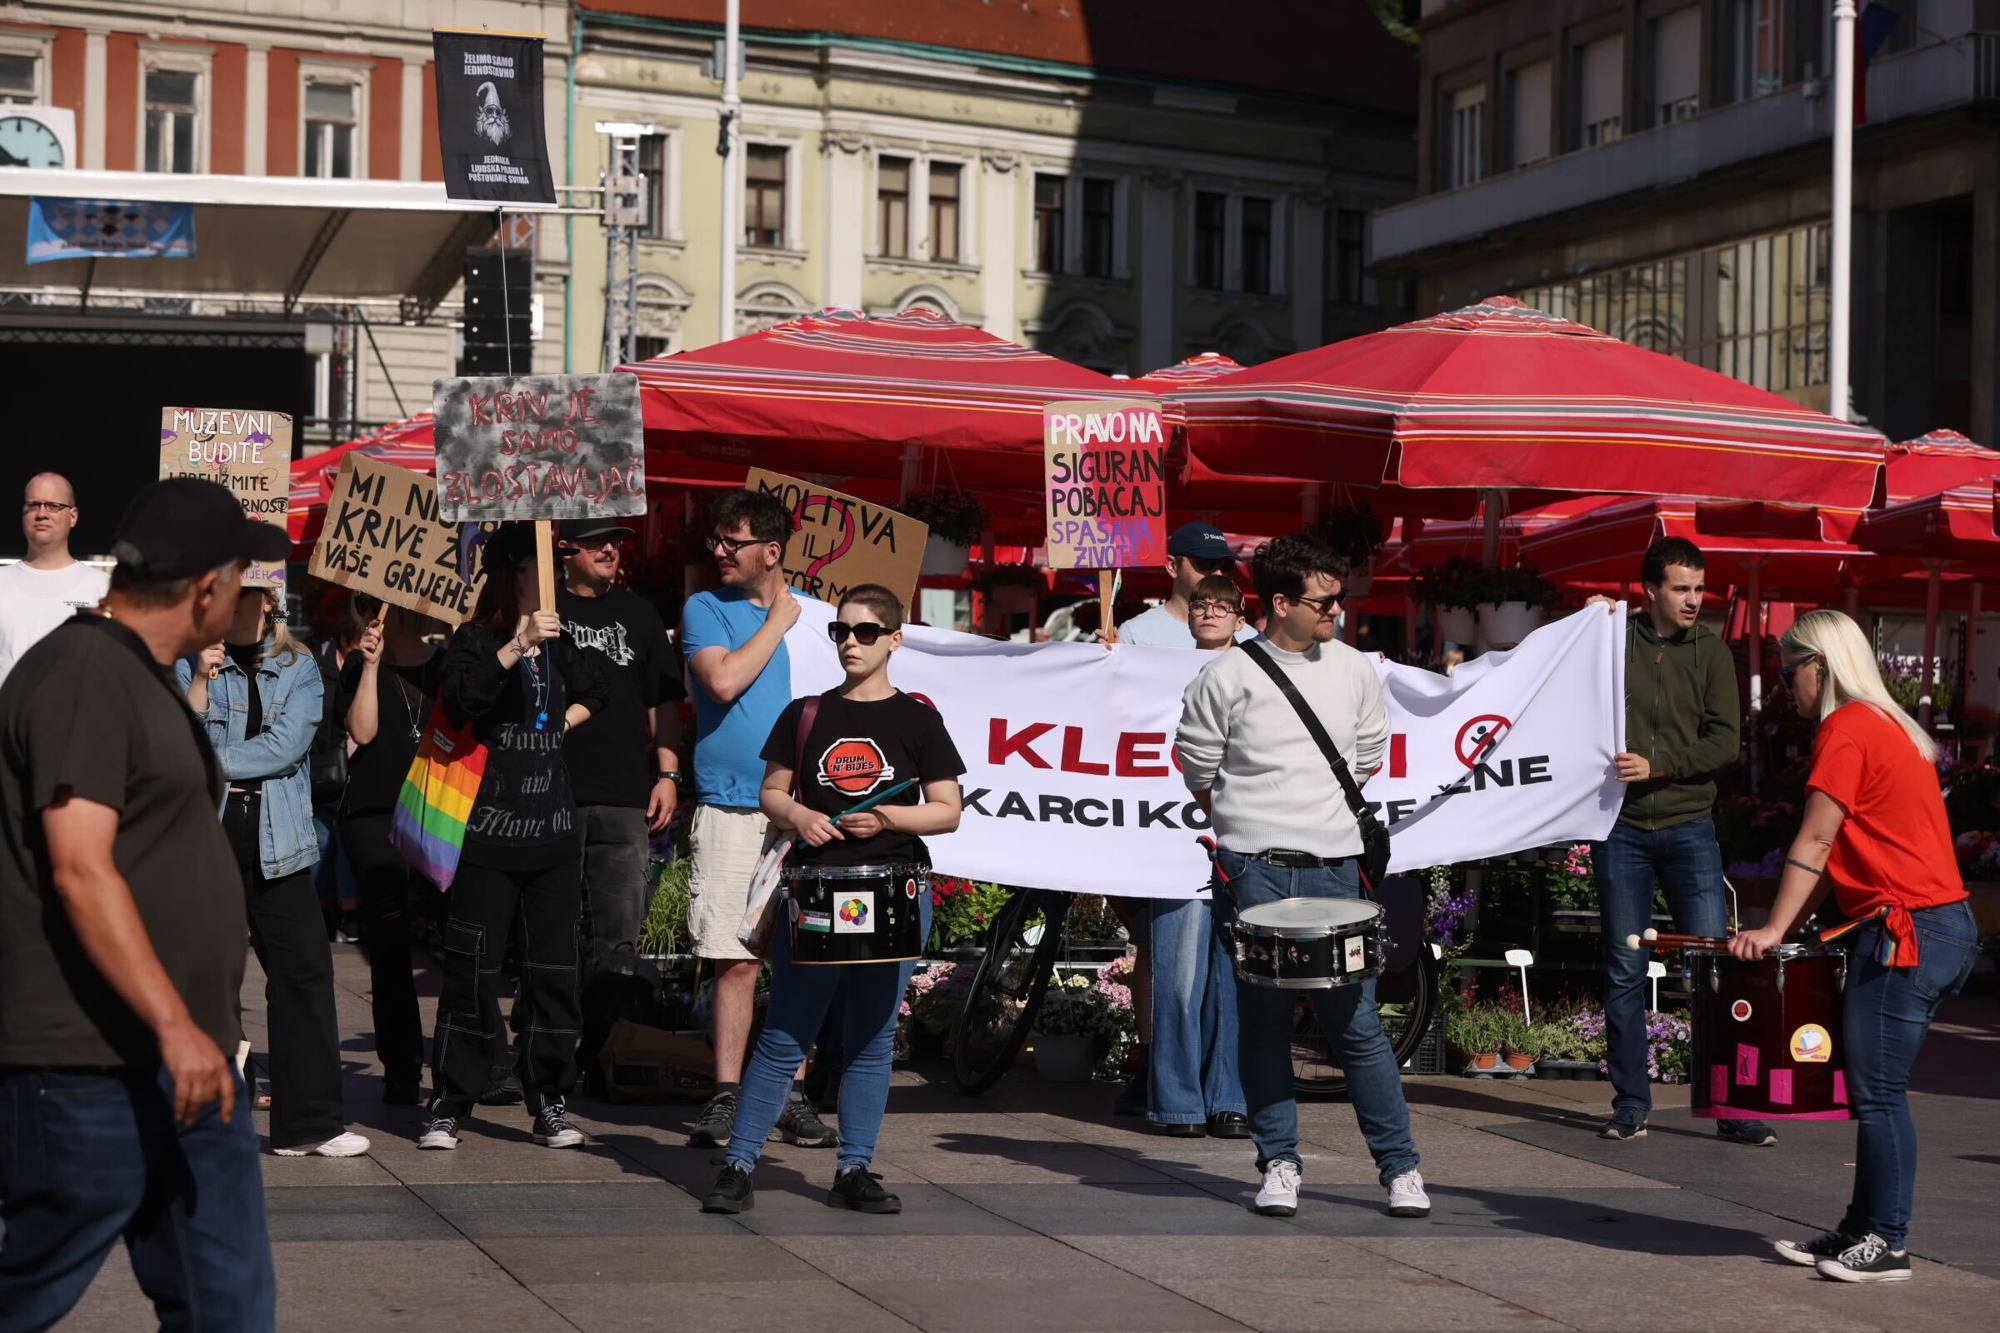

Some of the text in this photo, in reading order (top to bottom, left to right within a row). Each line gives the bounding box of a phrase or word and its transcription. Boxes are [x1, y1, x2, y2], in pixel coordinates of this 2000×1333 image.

[464, 52, 513, 67] ŽELIMO SAMO
[173, 409, 272, 437] MUŽEVNI
[469, 386, 600, 427] KRIV JE
[500, 426, 579, 456] SAMO
[1051, 412, 1164, 445] PRAVO NA
[188, 440, 265, 464] BUDITE
[1052, 448, 1165, 484] SIGURAN
[348, 466, 385, 506] MI
[442, 456, 645, 505] ZLOSTAVLJAČ
[1052, 481, 1163, 517] POBAČAJ
[332, 501, 427, 558] KRIVE
[802, 533, 835, 564] ILI
[325, 541, 475, 615] VAŠE GRIJEHE
[836, 755, 866, 764] DRUM
[845, 761, 875, 772] BIJES
